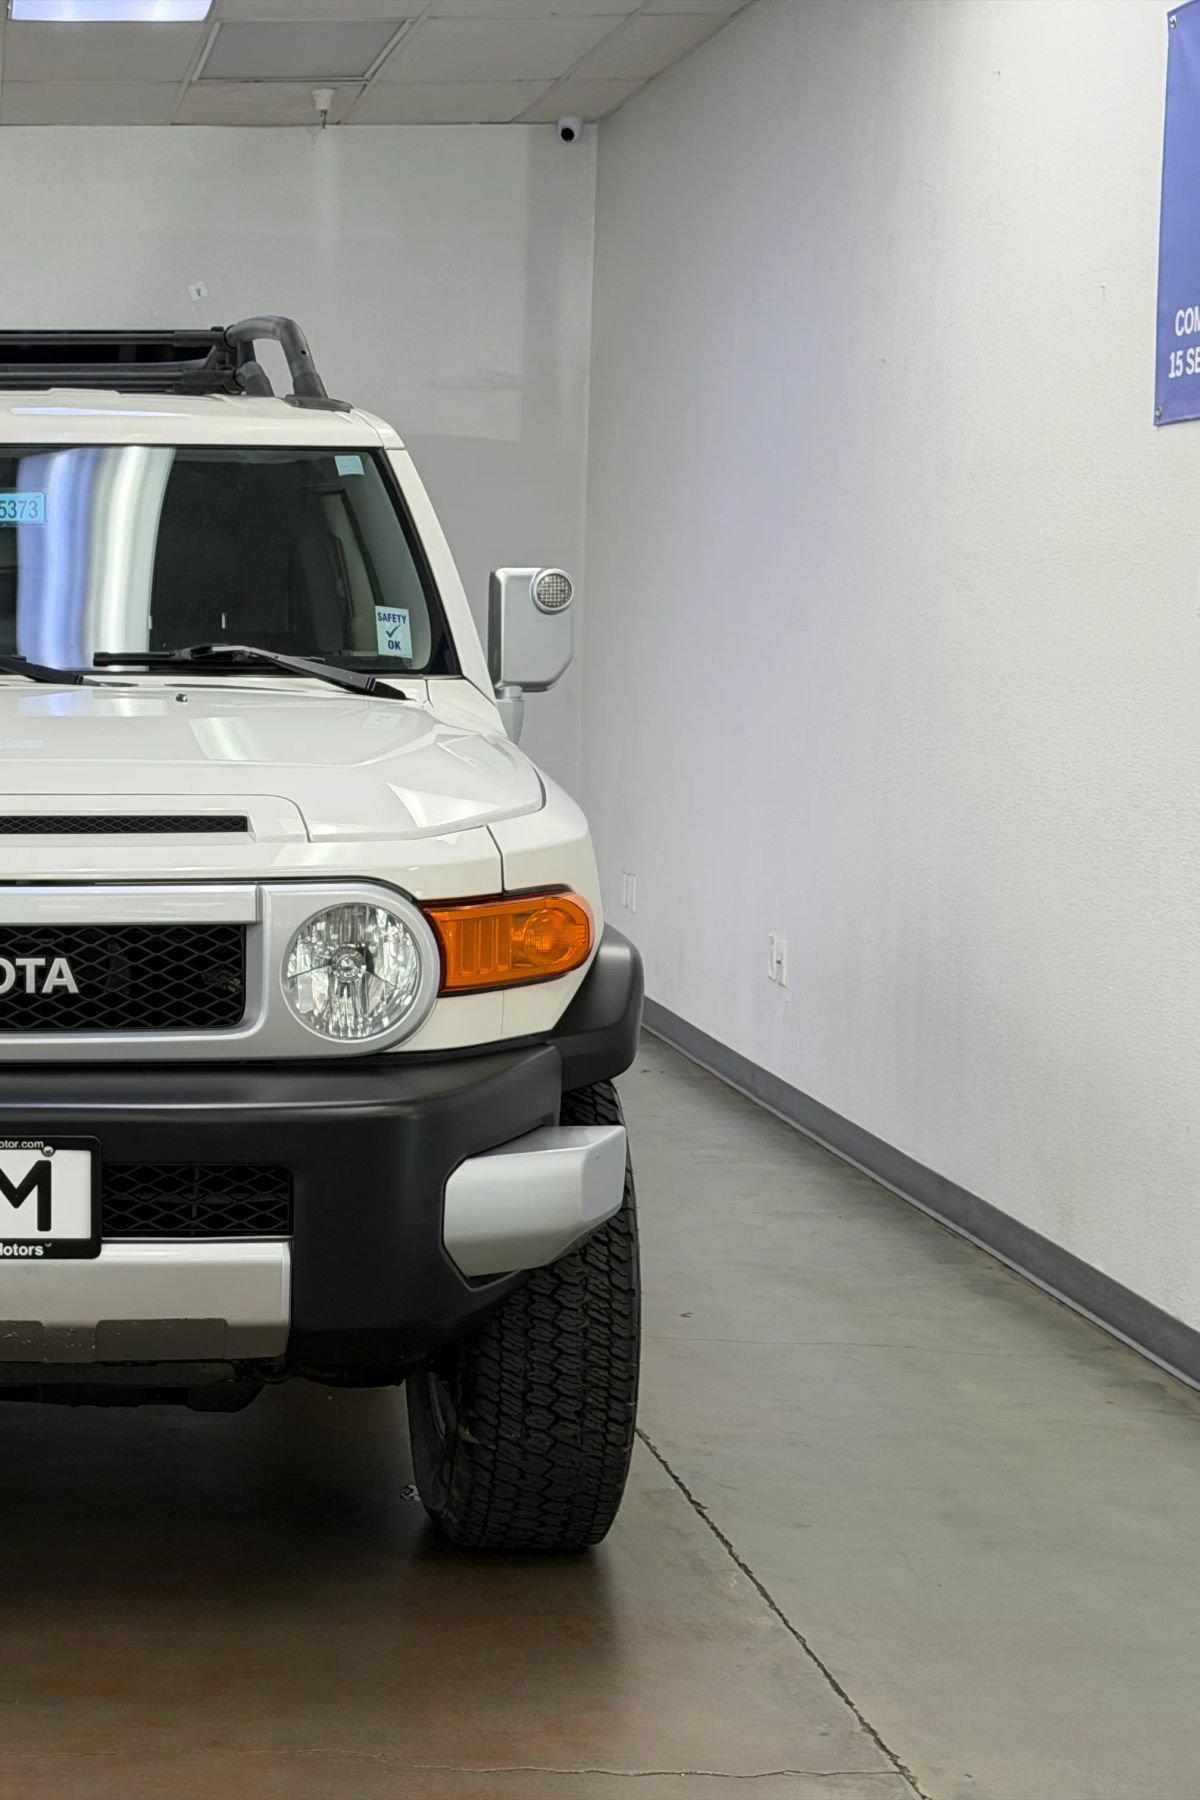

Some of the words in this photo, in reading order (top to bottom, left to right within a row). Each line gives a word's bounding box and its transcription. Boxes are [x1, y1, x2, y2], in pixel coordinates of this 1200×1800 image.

[1168, 349, 1184, 379] 15
[377, 611, 407, 625] SAFETY
[387, 639, 402, 651] OK
